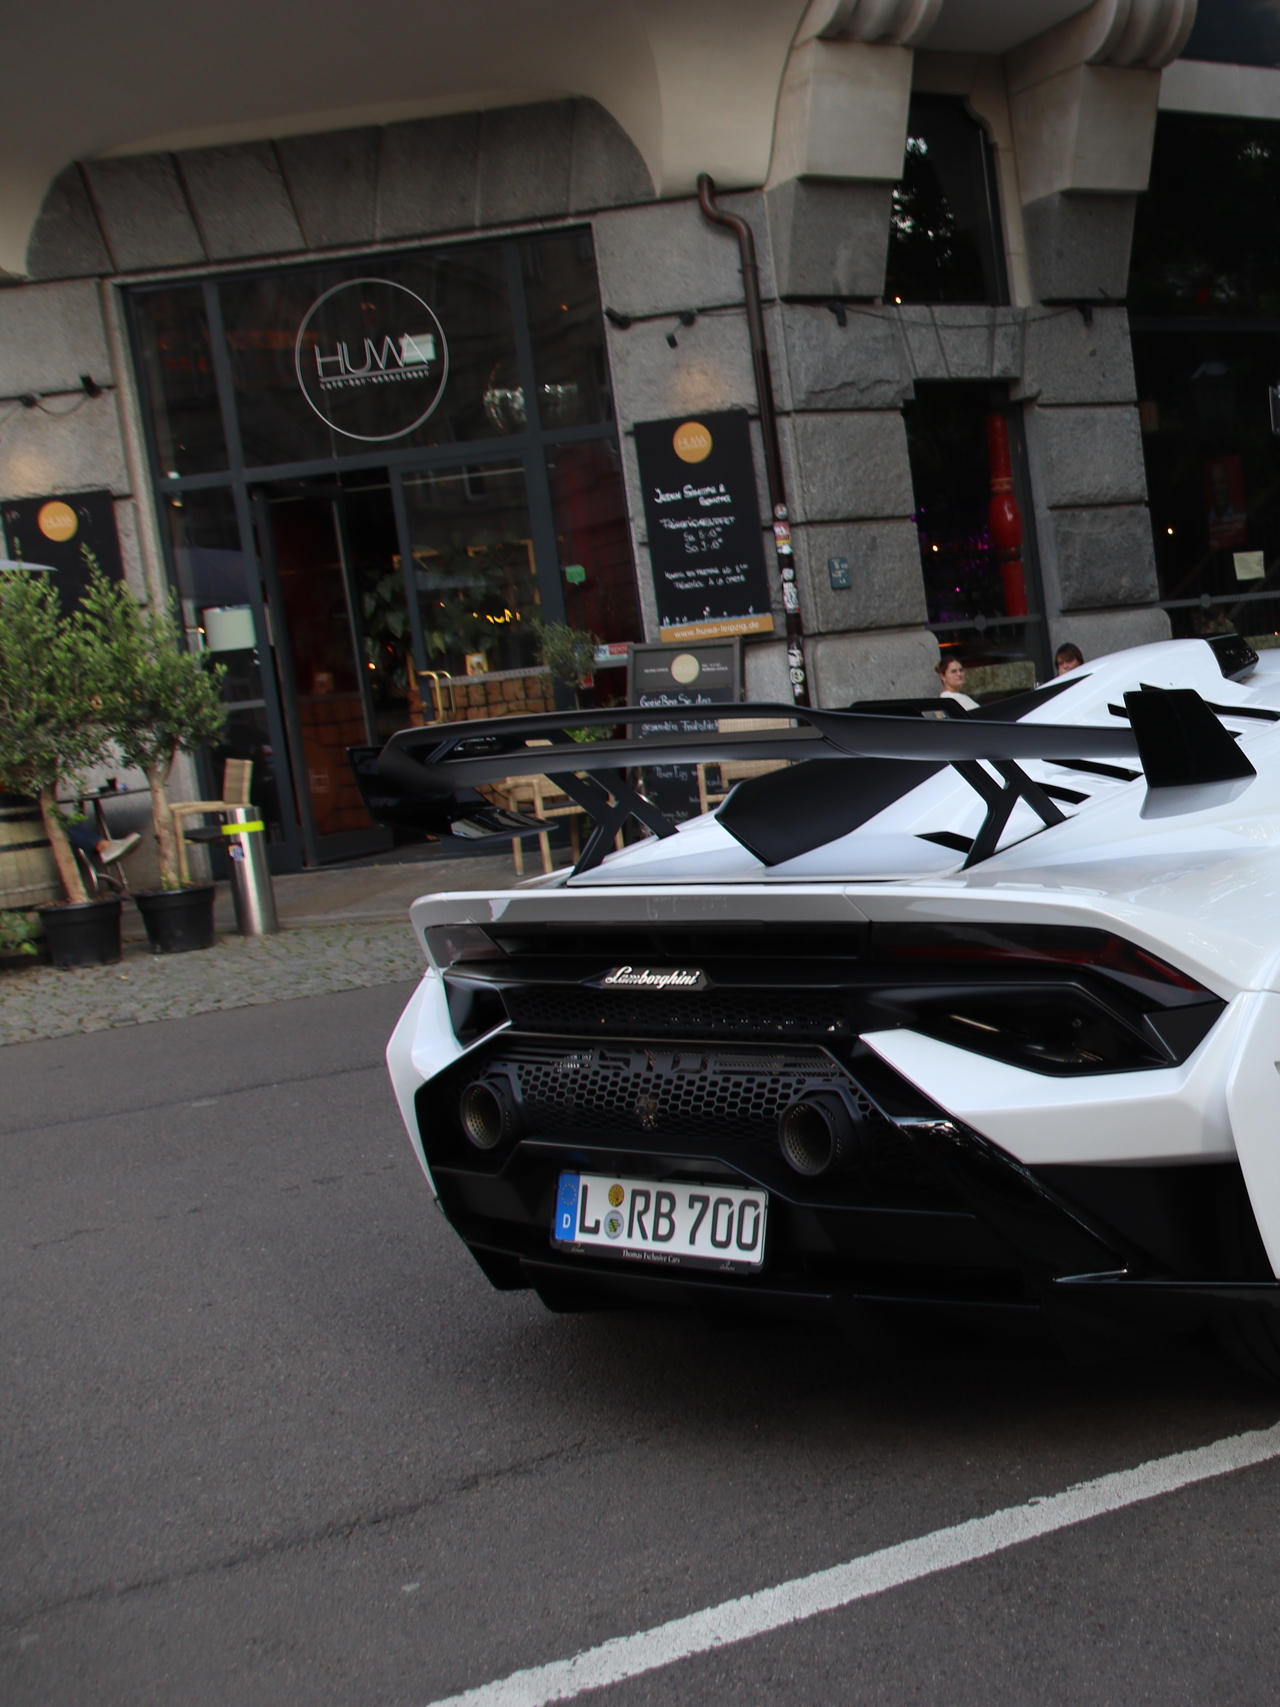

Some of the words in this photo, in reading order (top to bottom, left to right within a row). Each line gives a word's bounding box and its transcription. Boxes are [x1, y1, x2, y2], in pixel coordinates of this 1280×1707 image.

[314, 332, 429, 378] HUWA
[673, 620, 760, 639] www.huwa-leipzig.de
[604, 965, 701, 990] Lamborghini
[561, 1213, 571, 1229] D
[578, 1184, 601, 1235] L
[627, 1188, 676, 1243] RB
[688, 1193, 761, 1252] 700
[622, 1249, 643, 1260] Thomas
[643, 1251, 667, 1262] Exclusive
[668, 1254, 681, 1264] Cars
